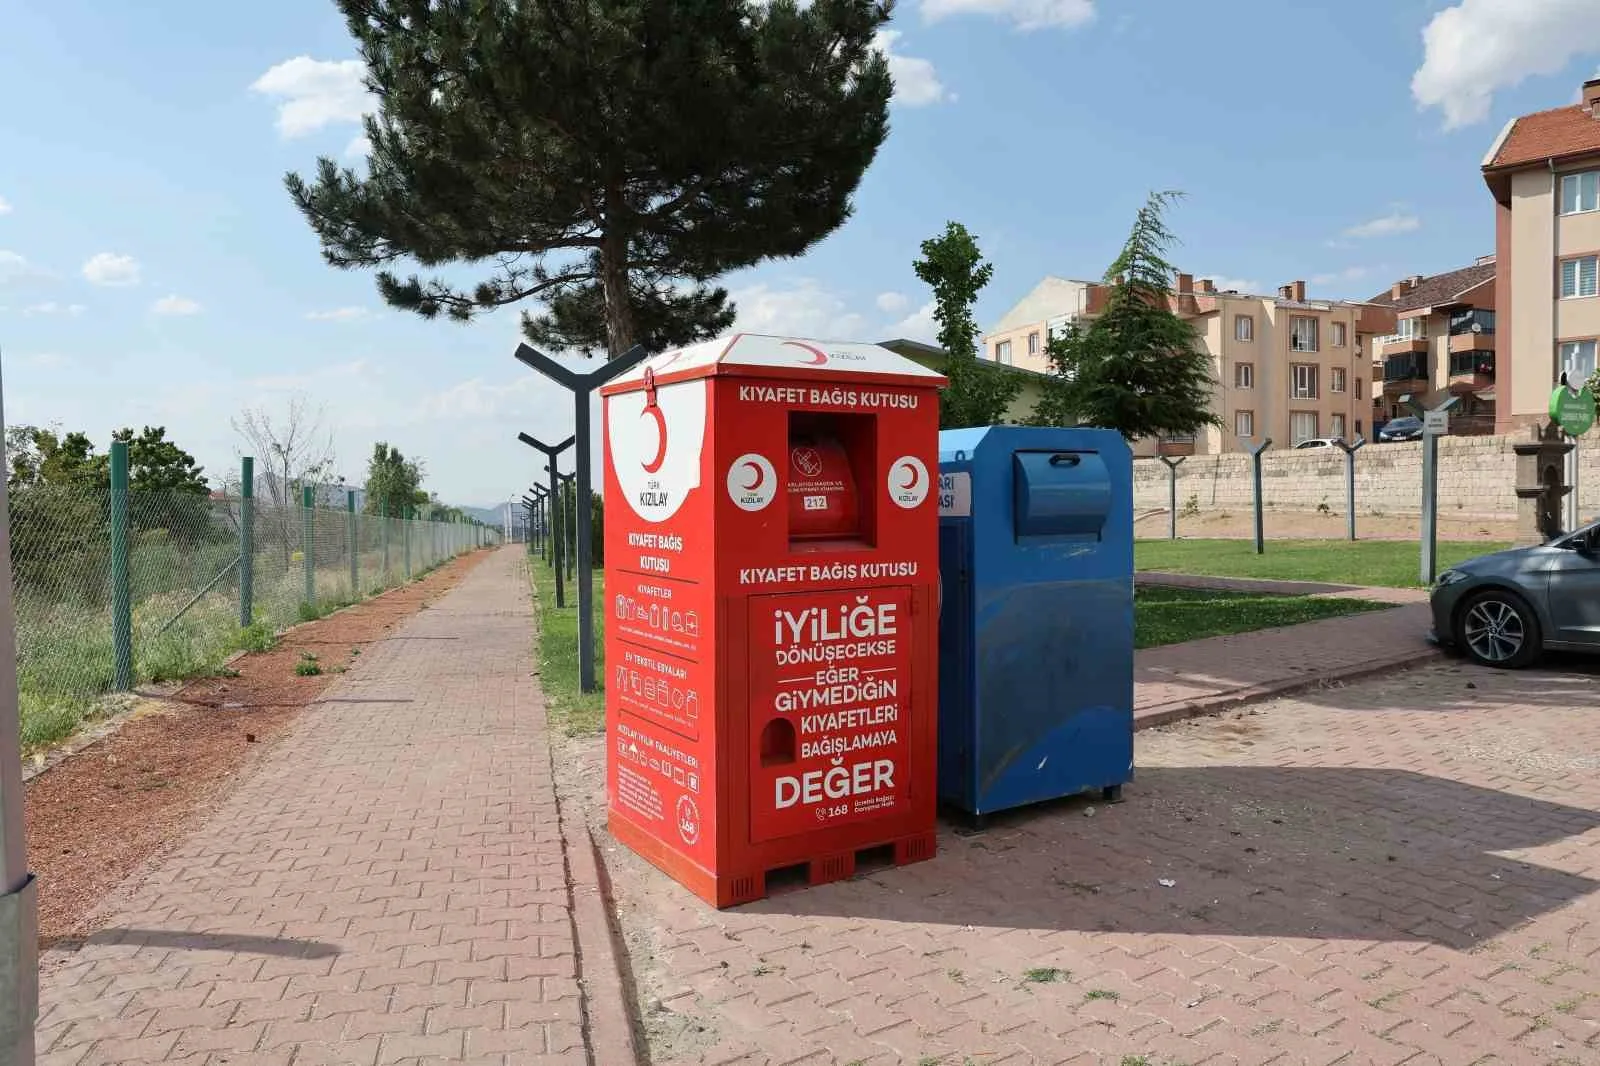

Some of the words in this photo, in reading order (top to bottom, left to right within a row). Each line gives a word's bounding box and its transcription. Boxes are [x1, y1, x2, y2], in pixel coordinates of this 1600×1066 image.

[739, 385, 805, 402] KIYAFET
[810, 387, 857, 408] BAĞIŞ
[860, 390, 918, 409] KUTUSU
[640, 491, 669, 508] KIZILAY
[628, 532, 657, 548] KIYAFET
[658, 533, 683, 553] BAĞIŞ
[640, 555, 670, 573] KUTUSU
[740, 566, 807, 584] KIYAFET
[810, 563, 857, 582] BAĞIŞ
[860, 561, 918, 578] KUTUSU
[776, 640, 896, 665] DÖNÜŞECEKSE
[816, 666, 859, 686] EĞER
[801, 730, 897, 759] BAĞIŞLAMAYA
[775, 756, 895, 809] DEĞER
[828, 804, 848, 818] 168
